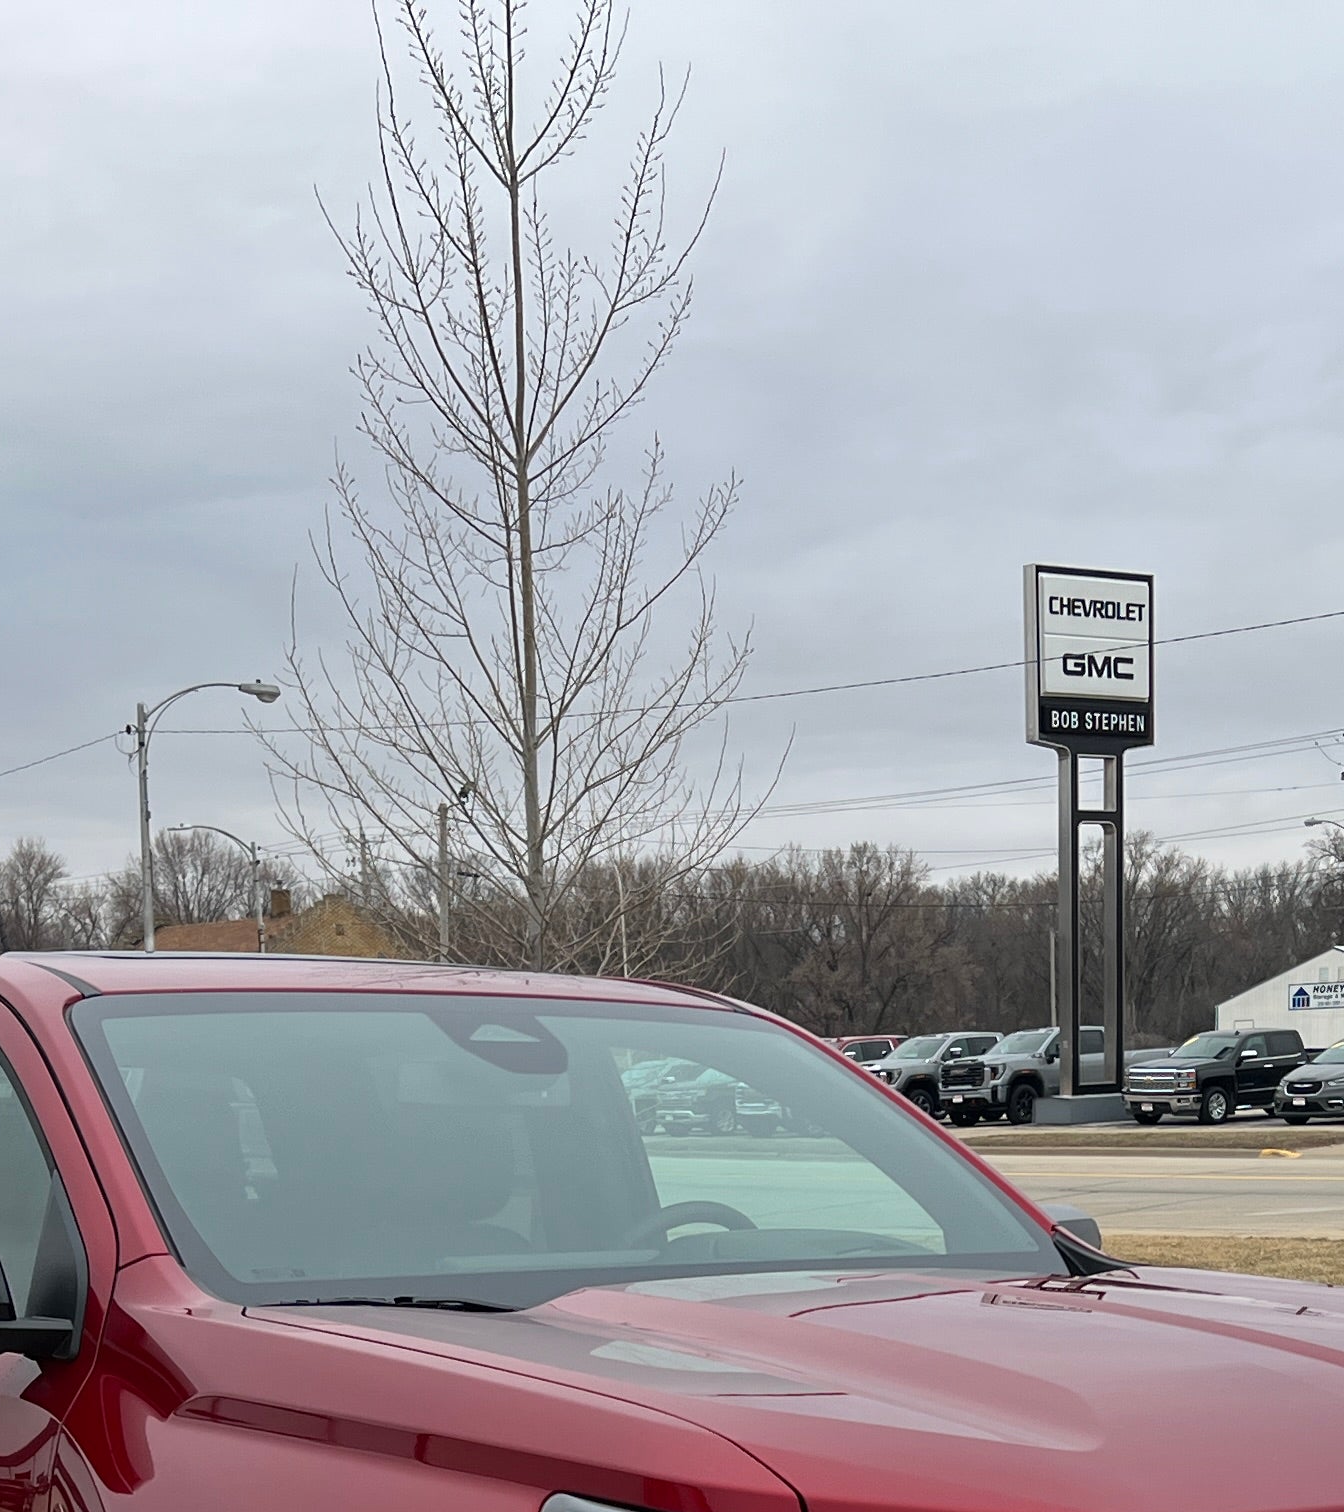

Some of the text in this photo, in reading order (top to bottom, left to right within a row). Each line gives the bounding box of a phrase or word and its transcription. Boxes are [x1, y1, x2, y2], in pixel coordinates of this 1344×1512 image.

[1049, 596, 1145, 621] CHEVROLET
[1062, 653, 1134, 680] GMC
[1051, 710, 1145, 732] BOB STEPHEN
